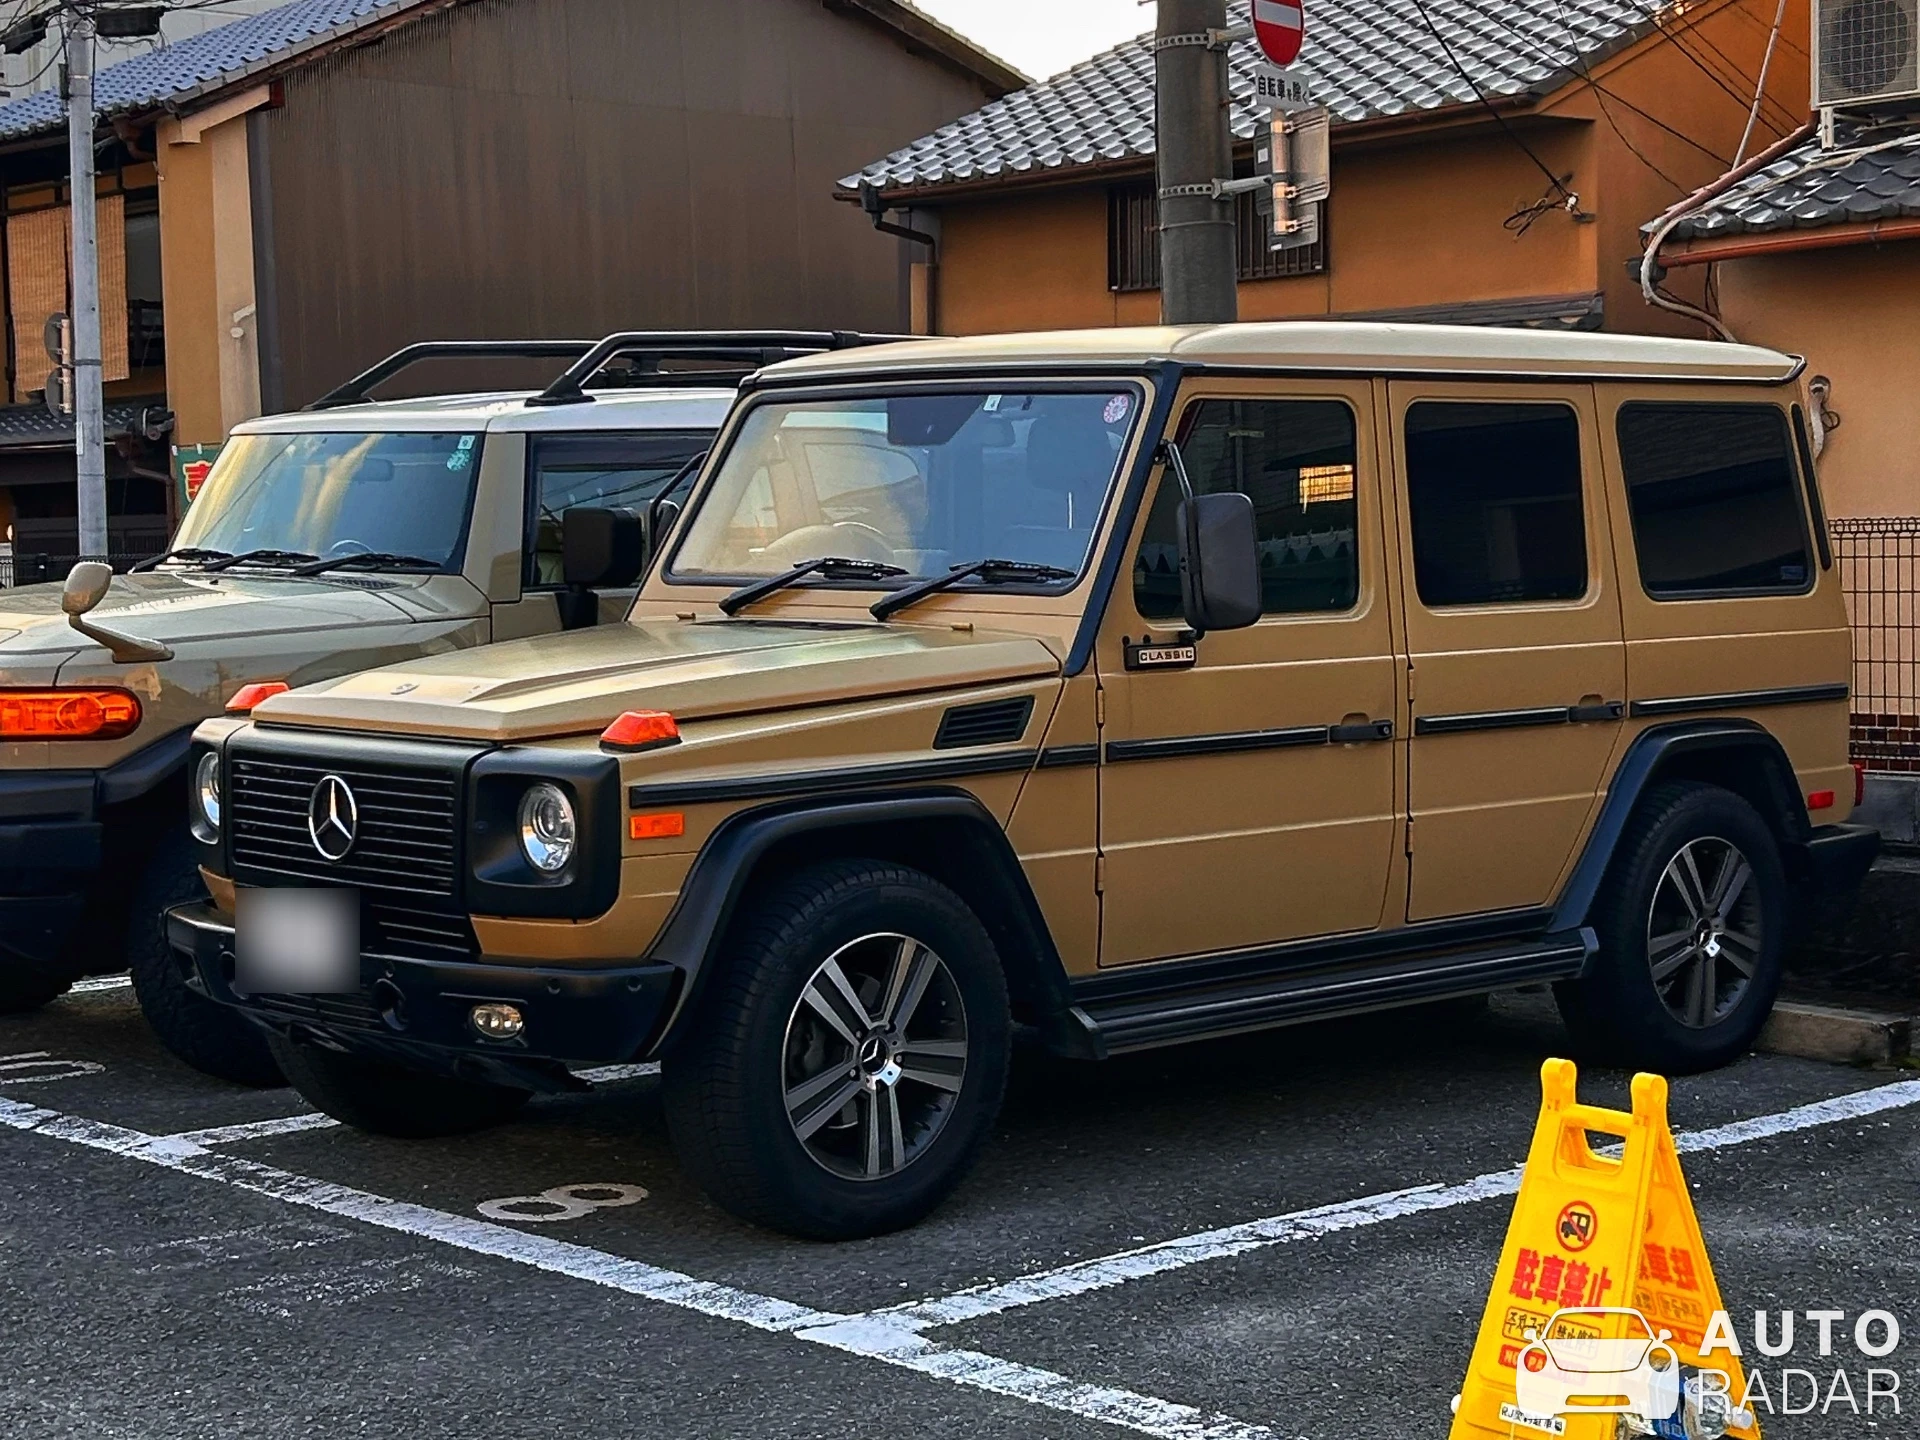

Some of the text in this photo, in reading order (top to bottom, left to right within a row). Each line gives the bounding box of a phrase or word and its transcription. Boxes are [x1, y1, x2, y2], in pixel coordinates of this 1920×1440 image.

[1258, 74, 1309, 105] 自転車を除く
[1140, 649, 1193, 661] CLASSIC
[476, 1182, 649, 1222] 8
[1509, 1248, 1612, 1319] 駐車禁止
